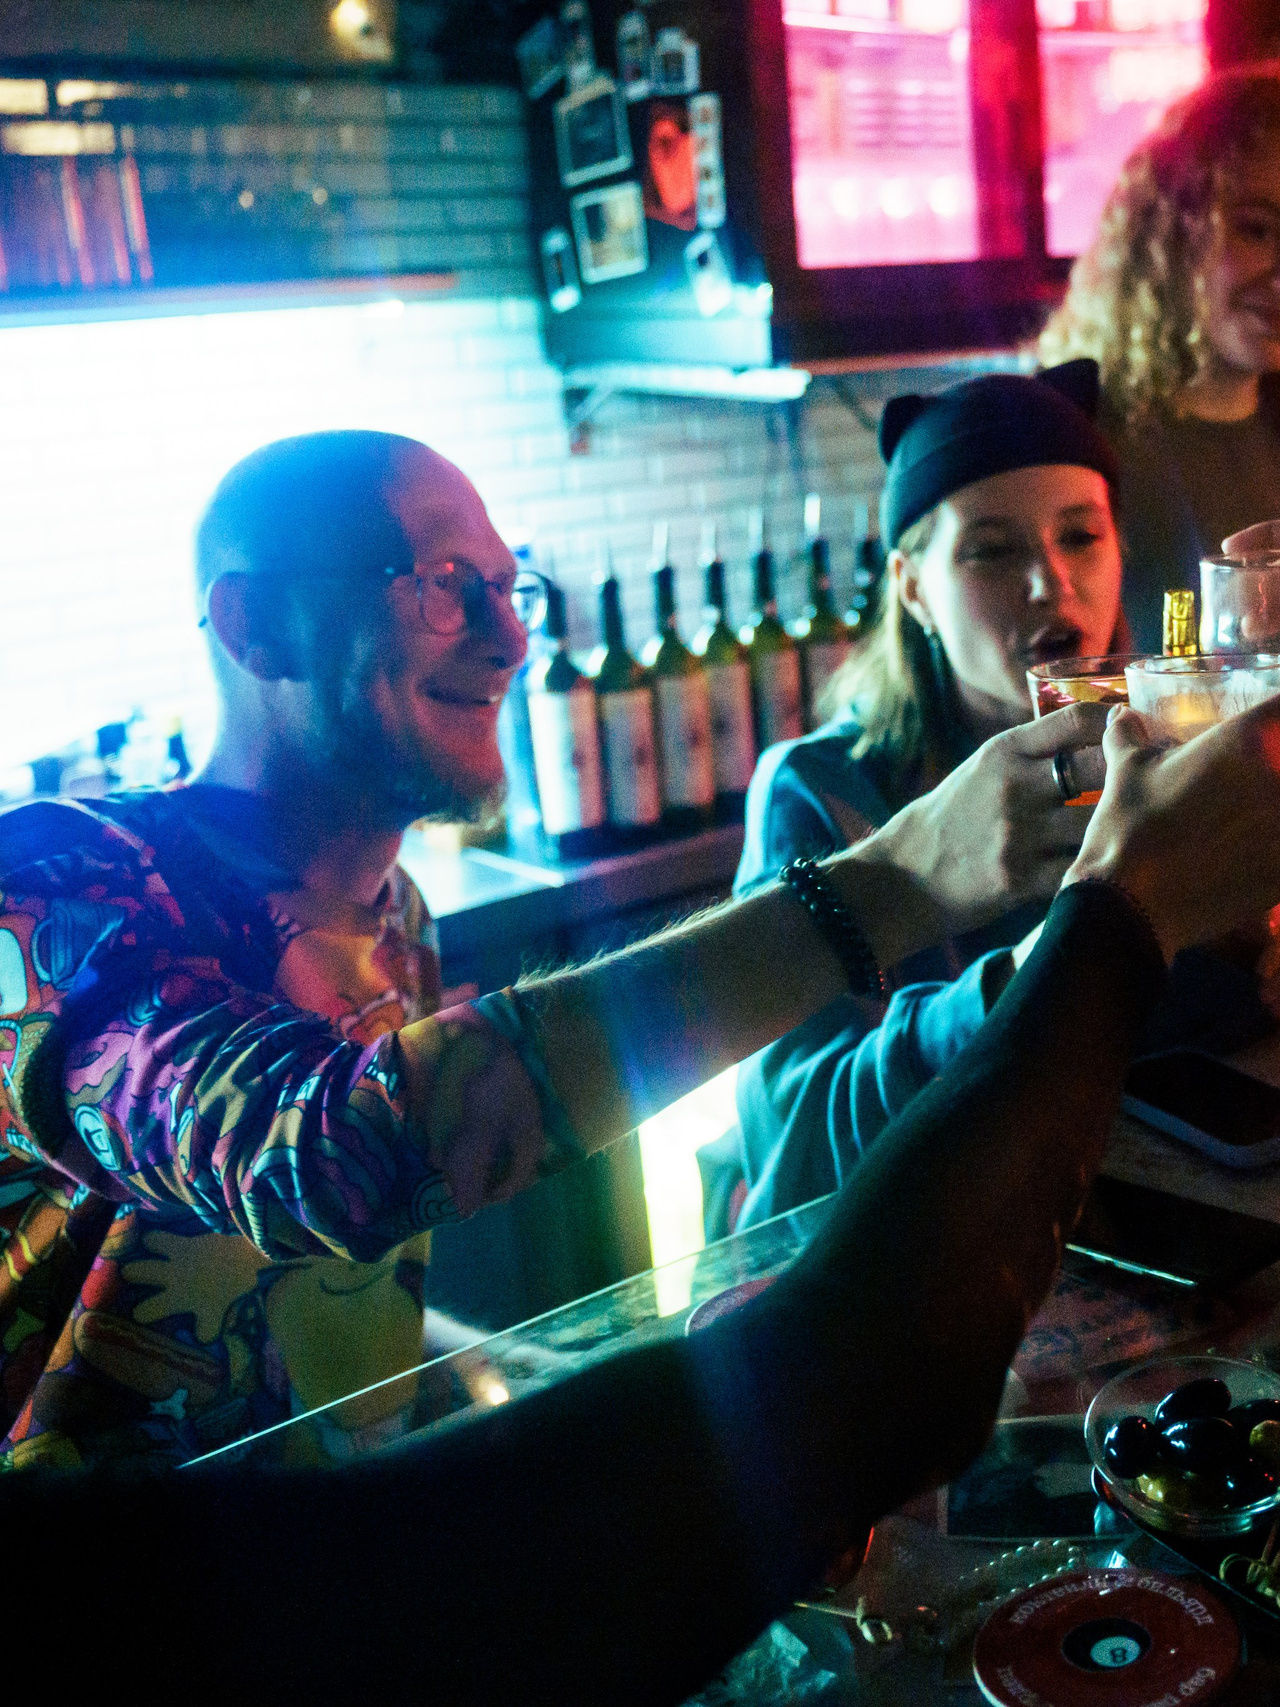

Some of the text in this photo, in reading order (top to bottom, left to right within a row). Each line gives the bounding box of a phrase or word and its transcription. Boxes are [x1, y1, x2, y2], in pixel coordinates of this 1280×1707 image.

[1137, 1576, 1215, 1626] бильярд
[1109, 1648, 1128, 1663] 8
[1178, 1666, 1217, 1697] бар
